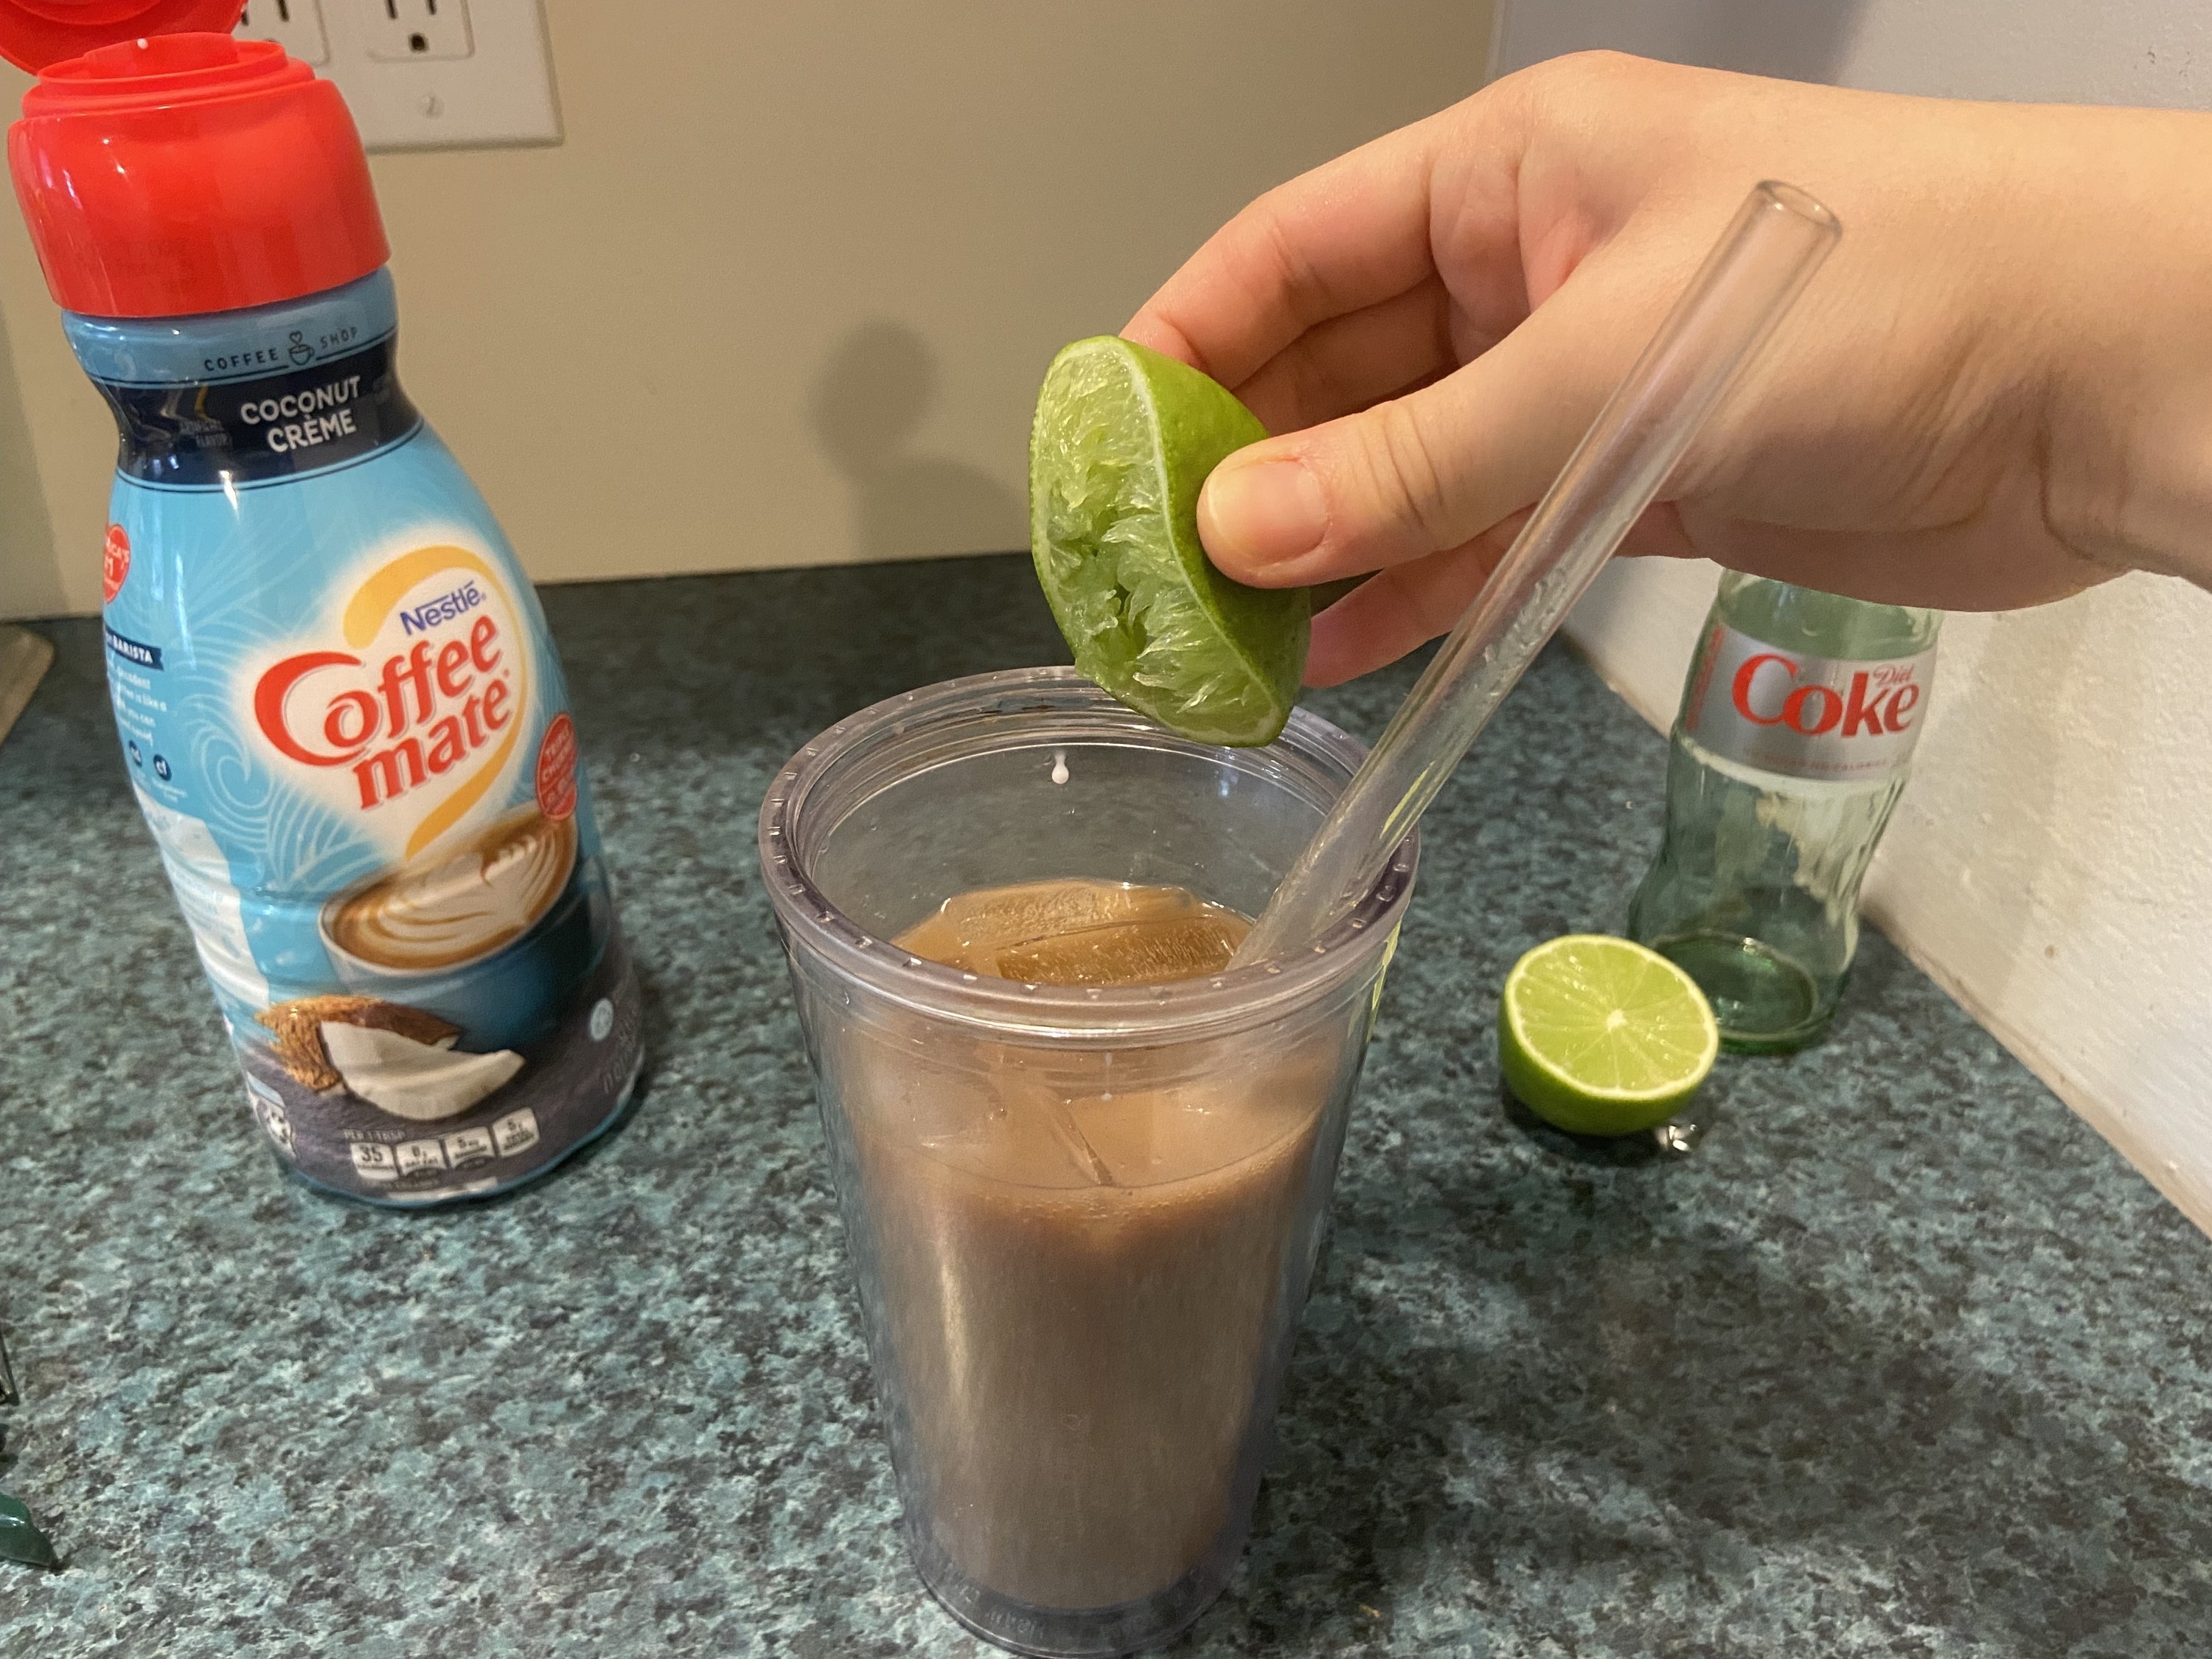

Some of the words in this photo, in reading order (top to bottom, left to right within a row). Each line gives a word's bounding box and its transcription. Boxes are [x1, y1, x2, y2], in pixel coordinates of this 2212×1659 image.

[204, 347, 278, 372] COFFEE
[320, 327, 358, 349] SHOP
[240, 375, 361, 425] COCONUT
[268, 408, 357, 453] CRÈME
[113, 635, 153, 664] BARISTA
[254, 615, 501, 768] Coffee
[1731, 653, 1920, 737] Coke
[1874, 664, 1915, 687] Diet
[352, 678, 512, 810] mate
[359, 1145, 383, 1162] 35
